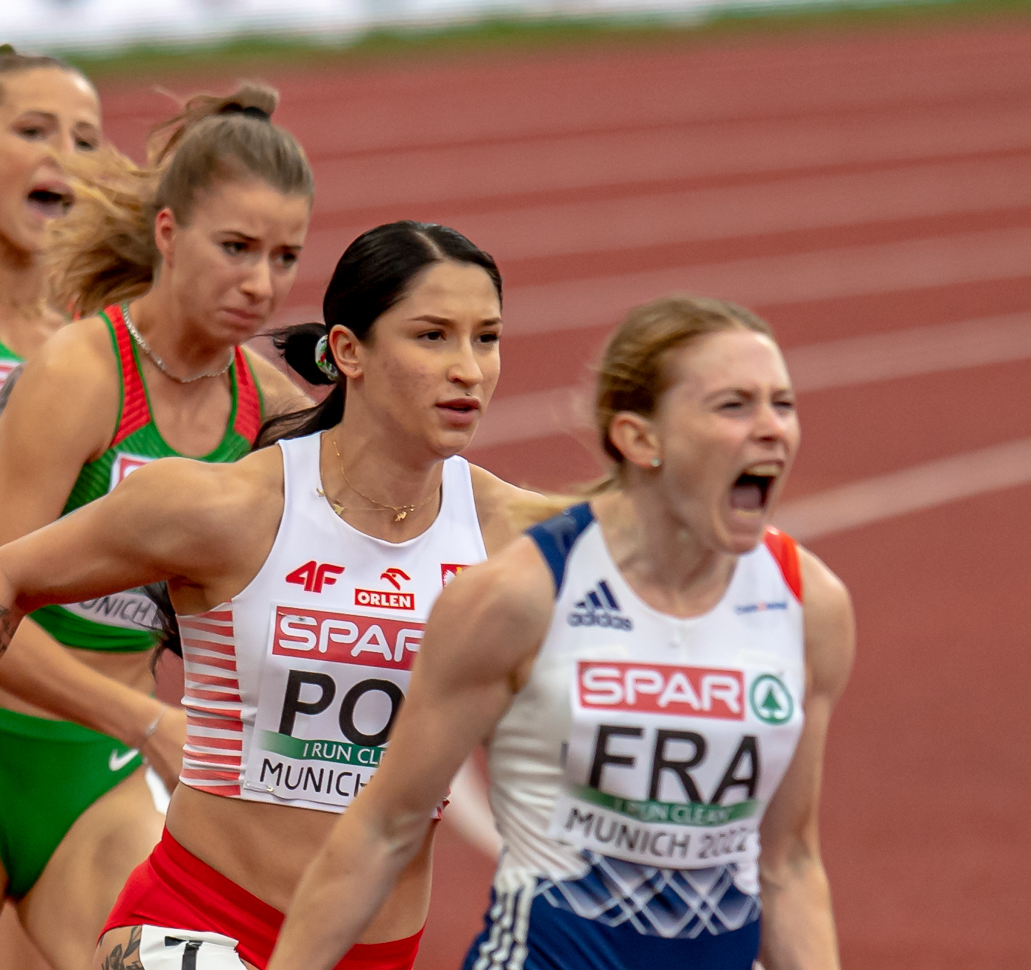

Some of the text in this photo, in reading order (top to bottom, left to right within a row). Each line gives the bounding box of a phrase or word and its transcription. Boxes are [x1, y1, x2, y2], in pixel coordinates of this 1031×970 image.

[285, 560, 346, 594] 4F
[357, 587, 412, 608] ORLEN
[568, 611, 633, 632] adidas
[582, 667, 741, 713] SPAR
[311, 743, 352, 761] RUN
[589, 724, 760, 805] FRA
[565, 807, 691, 859] MUNICH
